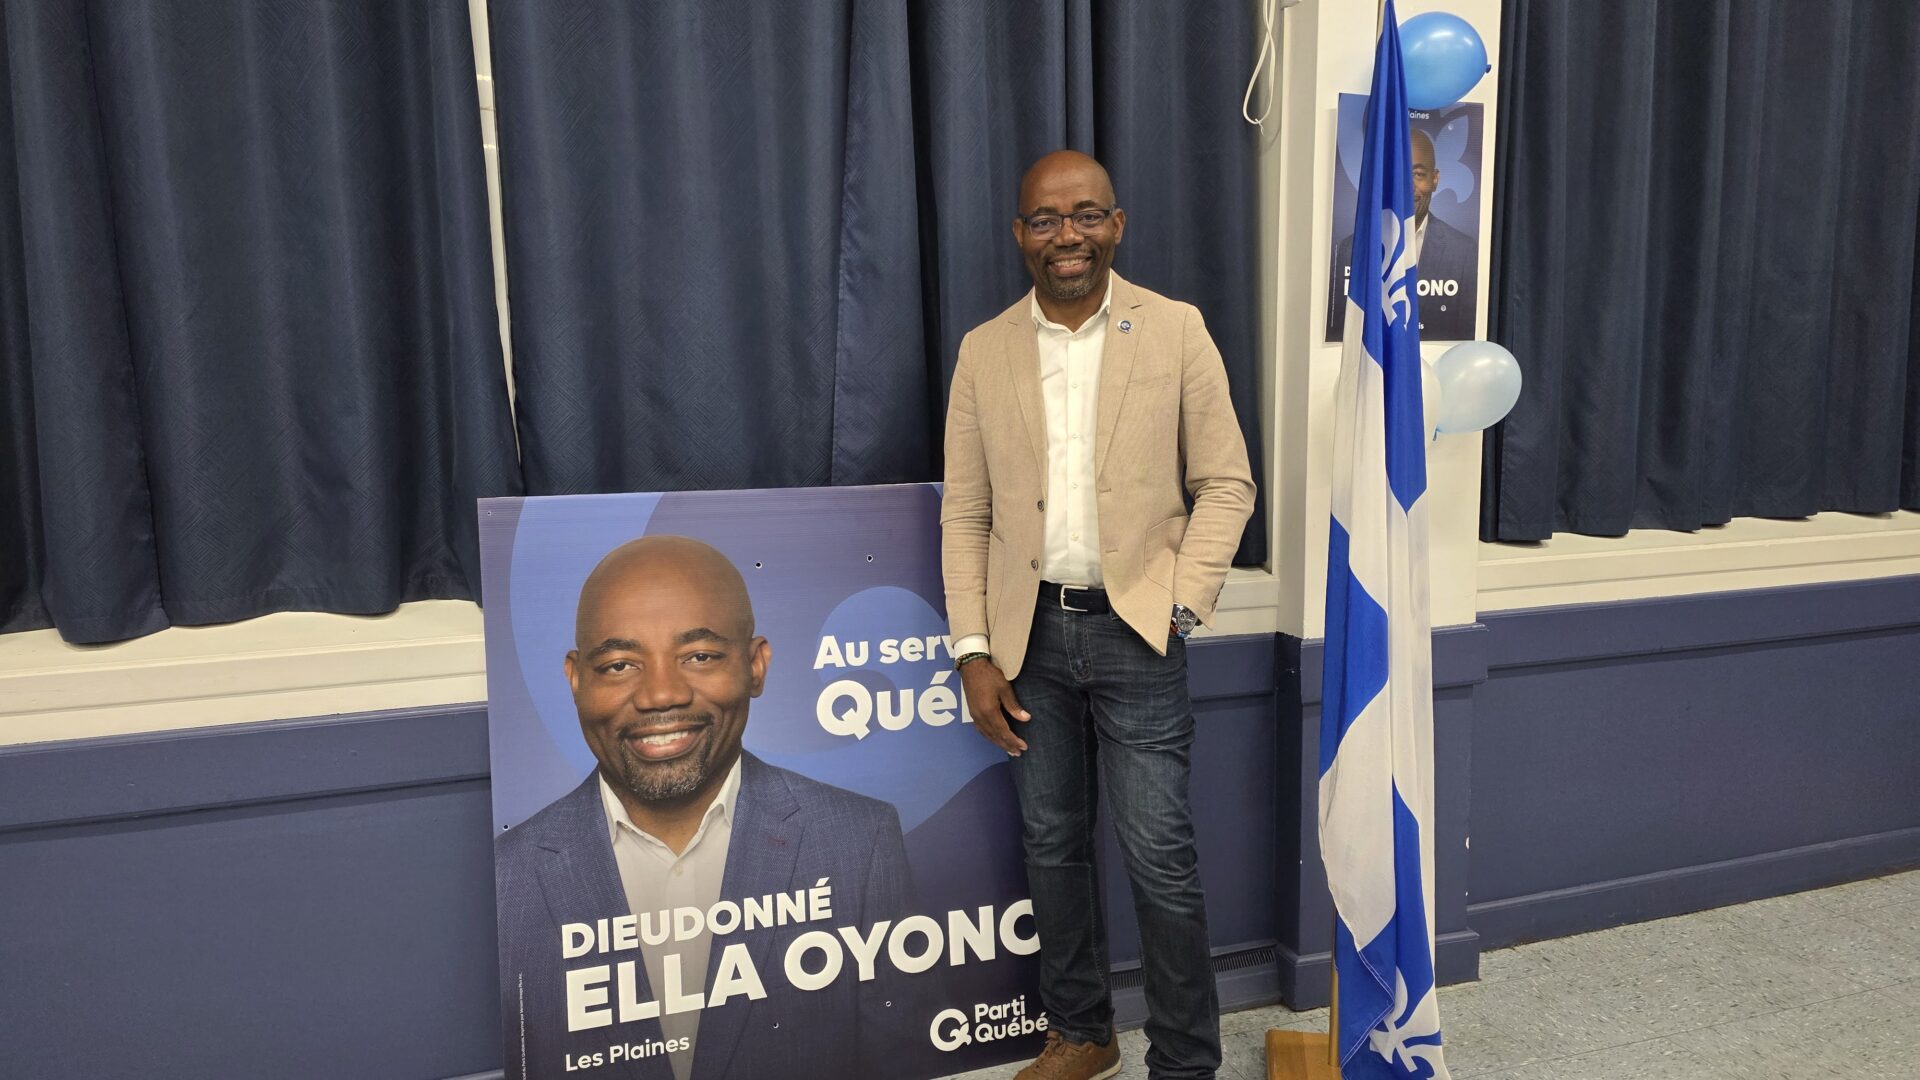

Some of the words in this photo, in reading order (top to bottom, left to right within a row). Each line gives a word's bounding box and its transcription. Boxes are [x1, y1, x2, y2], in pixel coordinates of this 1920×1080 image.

[812, 635, 869, 670] Au
[561, 877, 833, 959] DIEUDONNÉ
[566, 942, 768, 1033] ELLA
[974, 995, 1026, 1024] Parti
[565, 1051, 604, 1072] Les
[609, 1036, 690, 1064] Plaines
